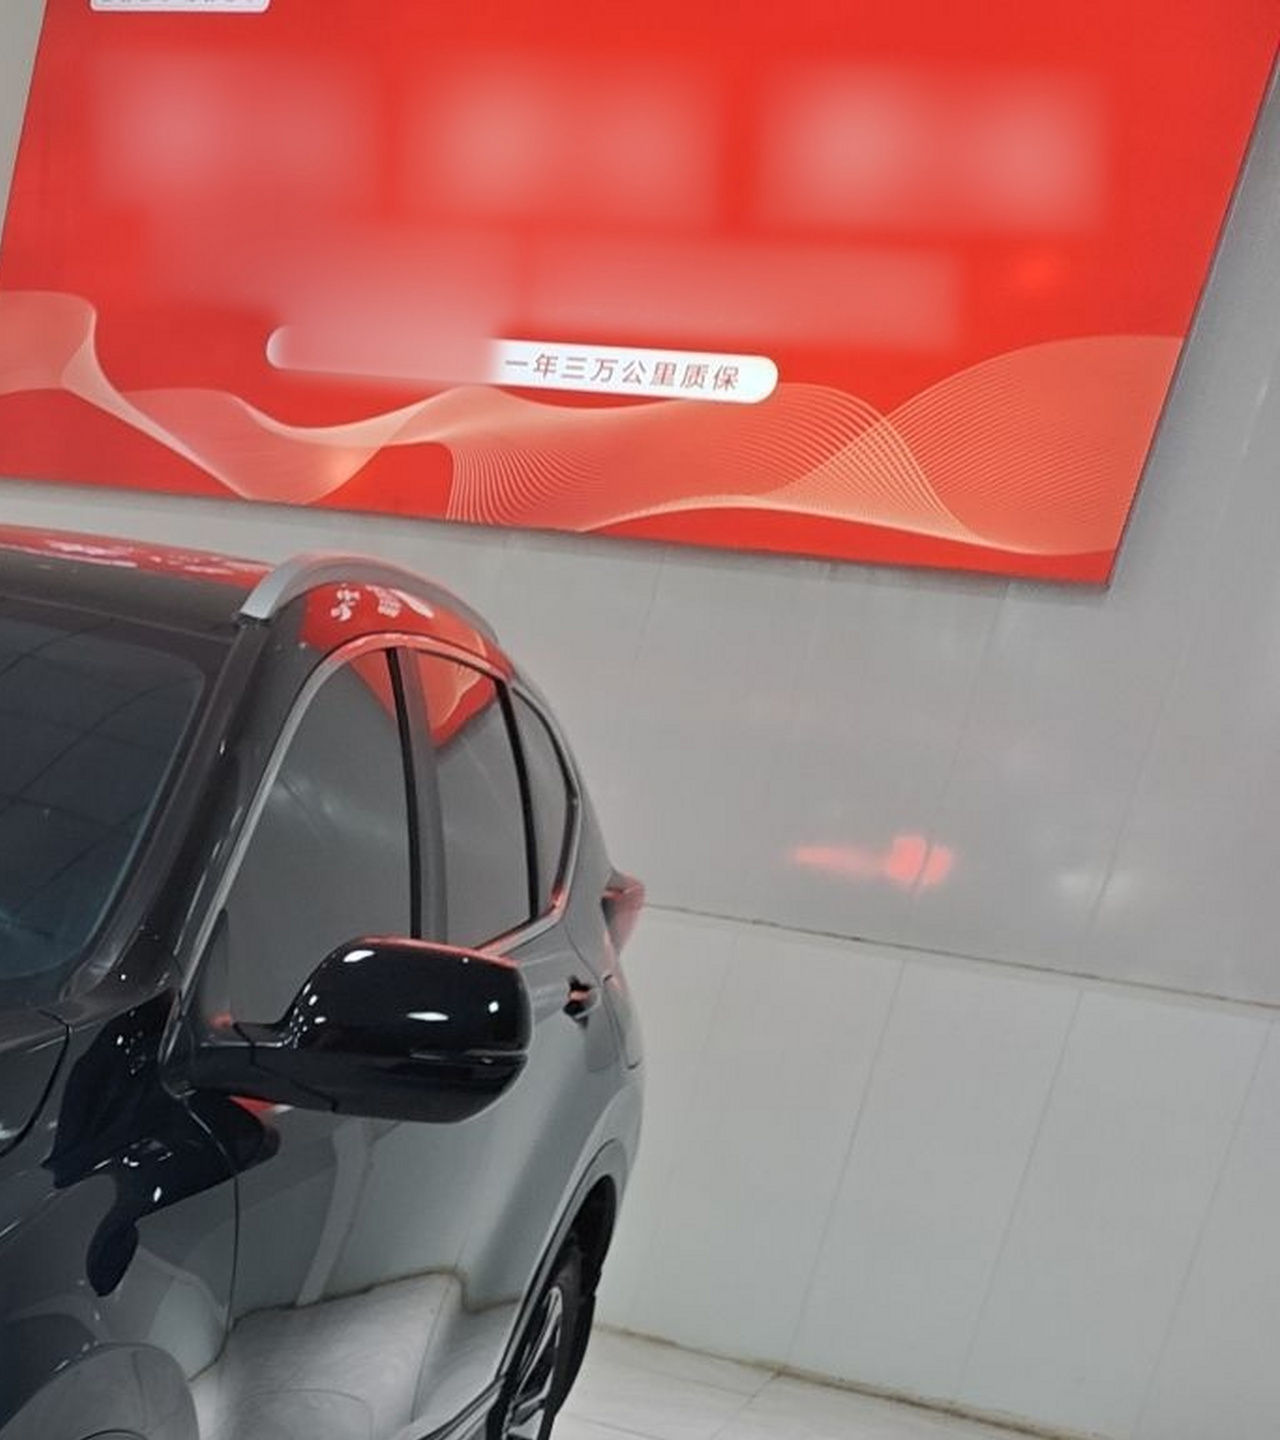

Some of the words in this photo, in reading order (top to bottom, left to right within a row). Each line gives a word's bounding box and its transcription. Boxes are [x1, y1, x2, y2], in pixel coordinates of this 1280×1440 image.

[504, 353, 740, 391] 一年三万公里质保
